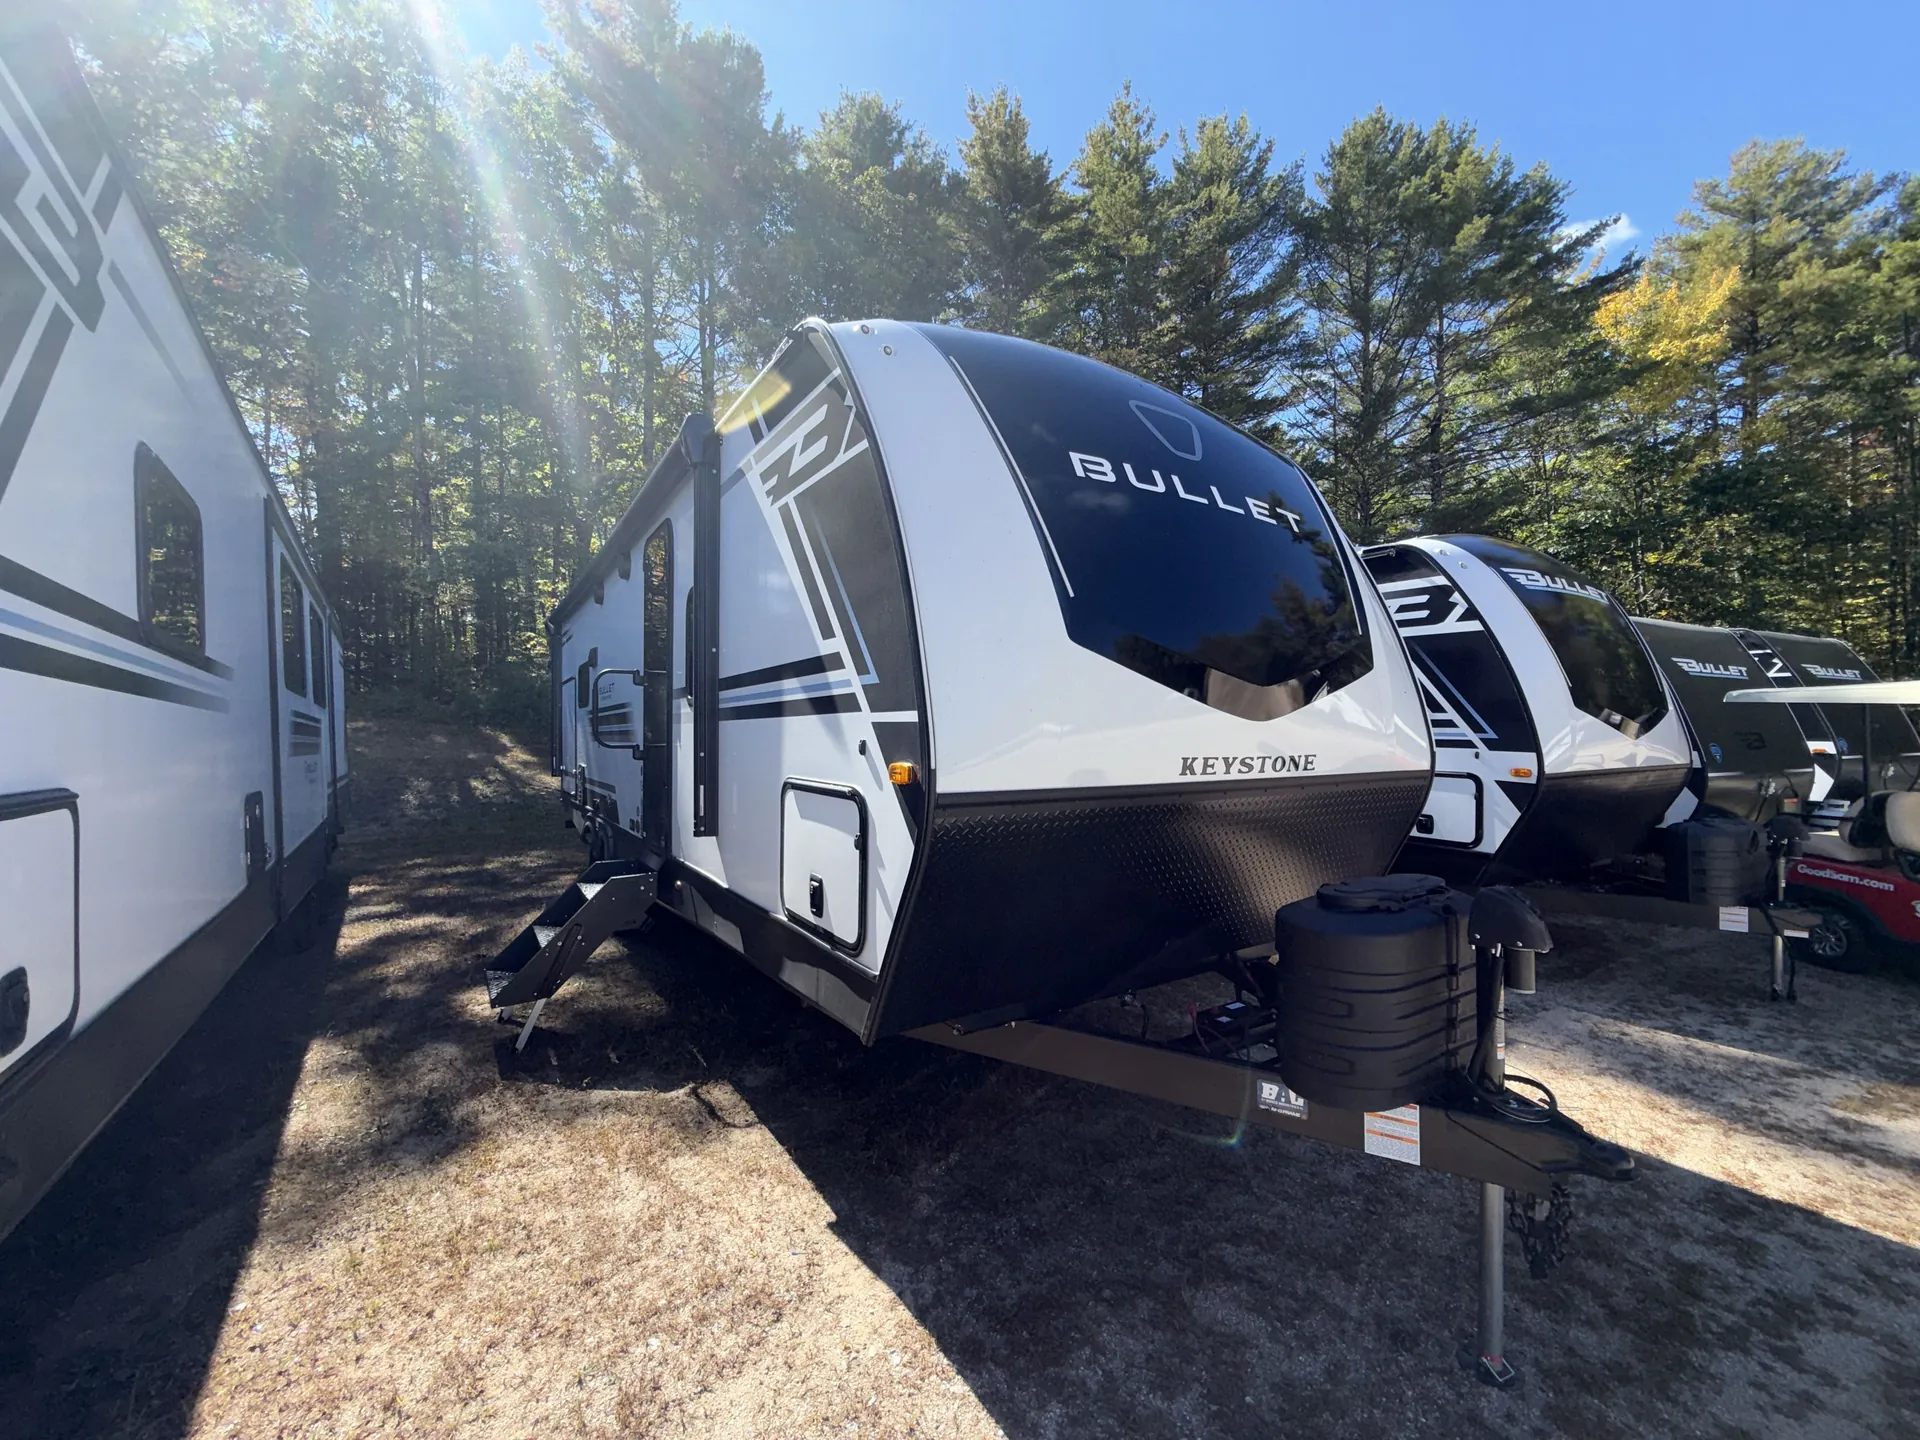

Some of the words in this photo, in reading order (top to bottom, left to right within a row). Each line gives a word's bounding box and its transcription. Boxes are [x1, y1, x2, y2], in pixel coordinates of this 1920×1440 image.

[1068, 451, 1301, 533] BULLET
[1500, 567, 1608, 601] BULLET
[1670, 657, 1748, 677] BULLET
[1800, 663, 1861, 678] BULLET
[1179, 754, 1317, 776] KEYSTONE
